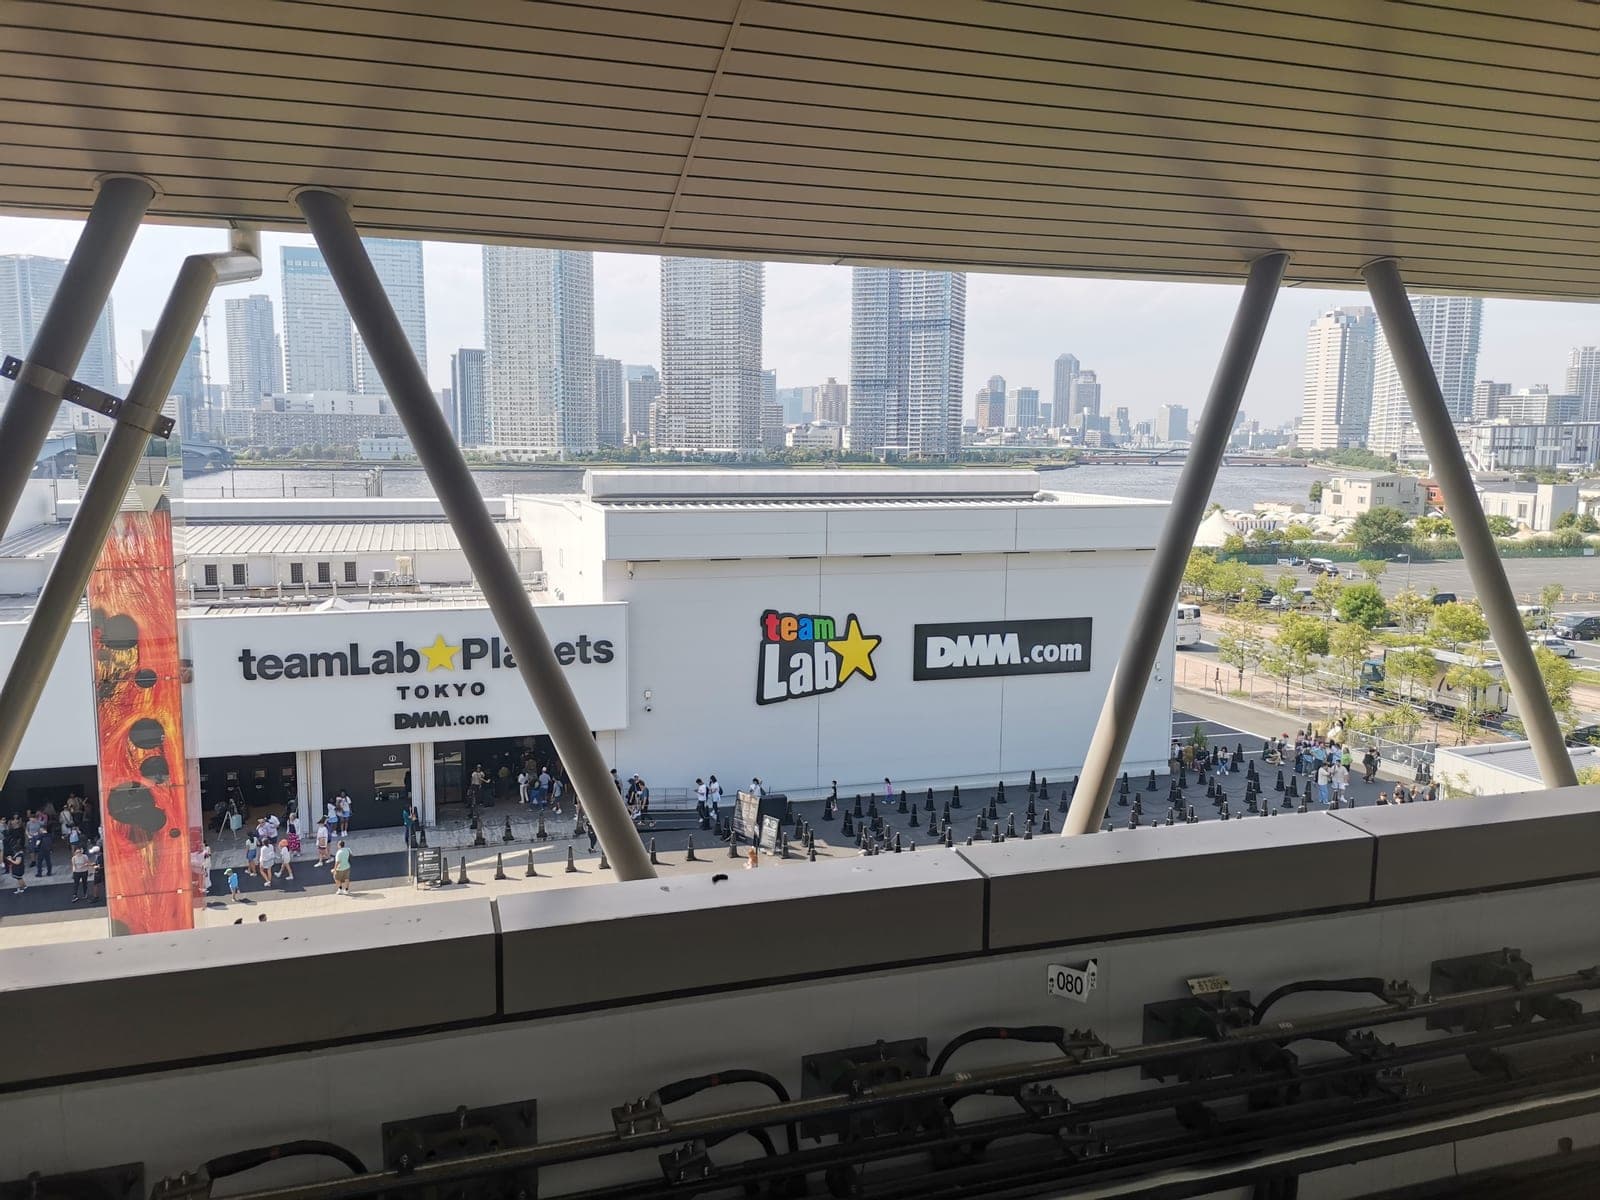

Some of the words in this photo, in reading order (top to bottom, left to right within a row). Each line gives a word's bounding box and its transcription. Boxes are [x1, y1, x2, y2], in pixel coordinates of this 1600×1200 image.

[765, 612, 835, 642] team
[238, 640, 421, 681] teamLab
[461, 634, 615, 671] Plets
[926, 632, 1082, 669] DMM.com
[763, 641, 838, 700] Lab
[396, 682, 485, 700] TOKYO
[394, 710, 489, 730] DMM.com
[1057, 971, 1083, 996] 080
